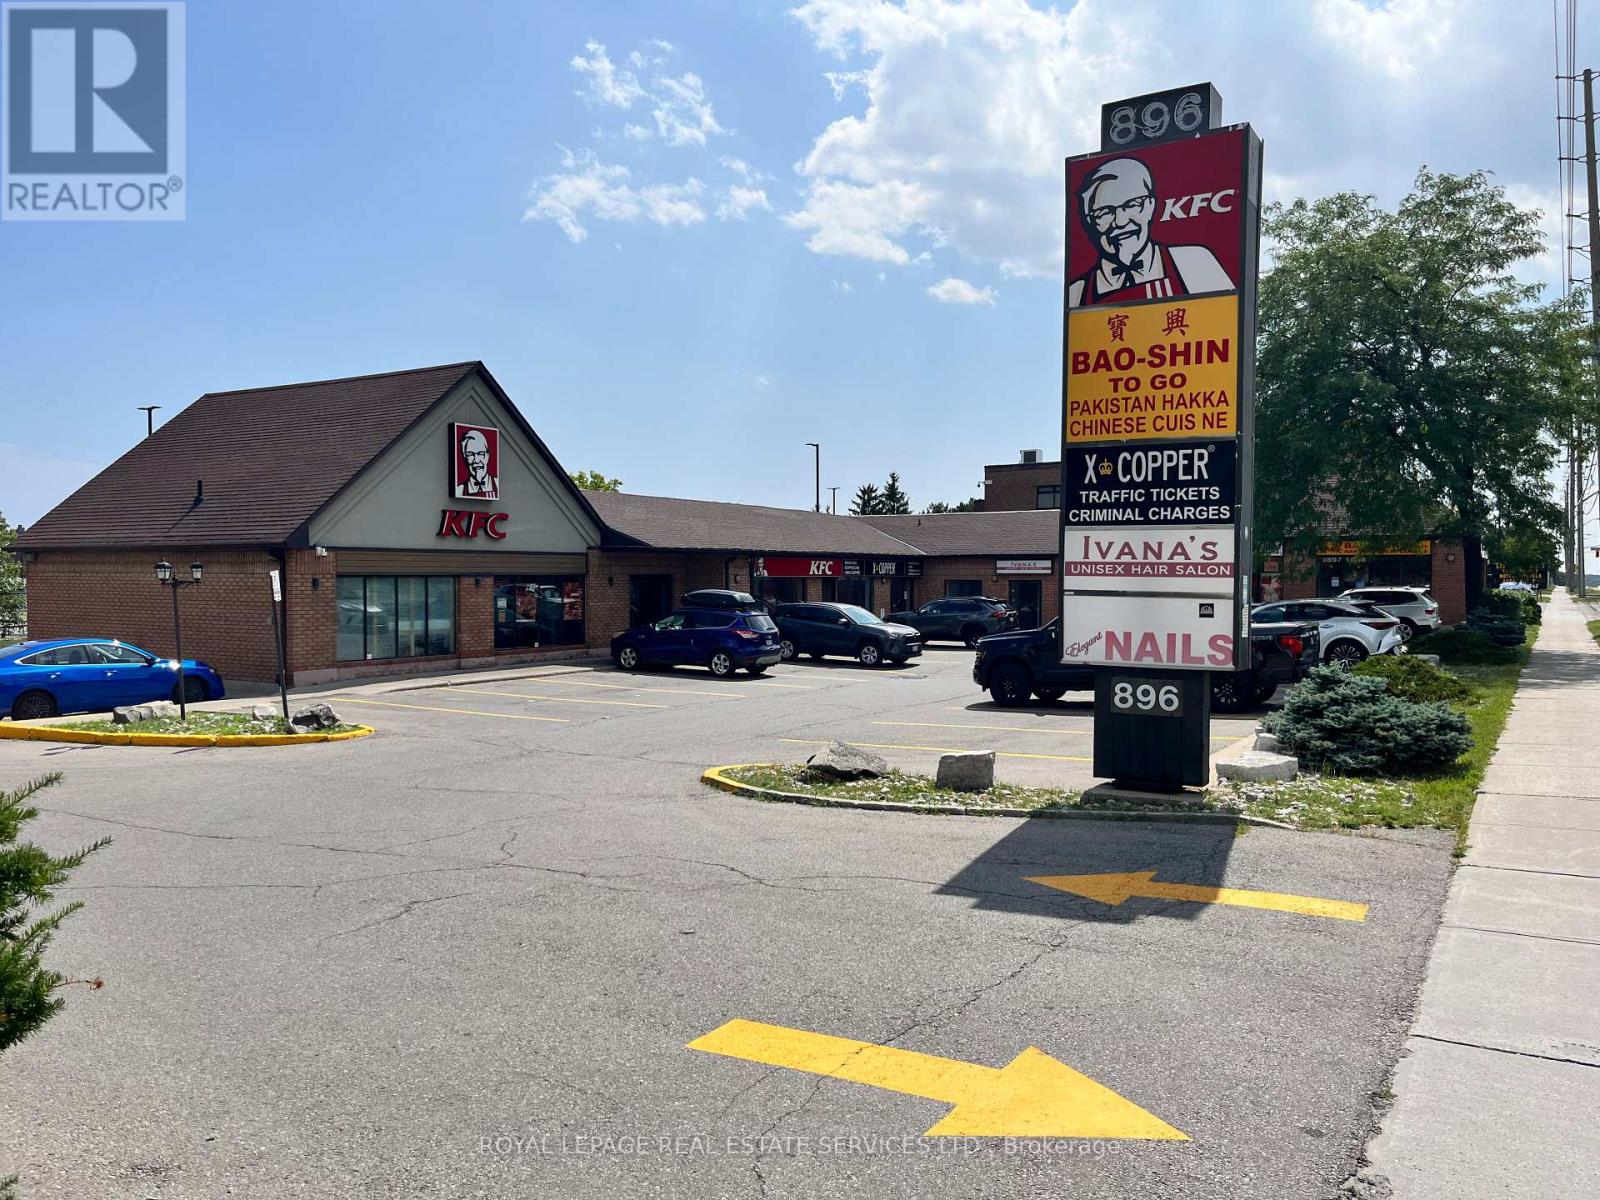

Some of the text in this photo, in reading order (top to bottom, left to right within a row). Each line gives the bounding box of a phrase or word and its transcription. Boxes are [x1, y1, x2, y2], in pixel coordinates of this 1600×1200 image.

[1110, 92, 1203, 145] 896
[1159, 189, 1236, 222] KFC
[1071, 338, 1230, 375] BAO-SHIN
[1108, 372, 1187, 393] TO GO
[1070, 390, 1230, 417] PAKISTAN HAKKA
[1069, 416, 1147, 437] CHINESE
[1084, 454, 1097, 484] X
[1079, 486, 1220, 503] TRAFFIC TICKETS
[436, 509, 509, 540] KFC
[1068, 506, 1231, 522] CRIMINAL CHARGES
[1082, 535, 1218, 561] IVANA'S
[809, 560, 833, 575] KFC
[1071, 564, 1231, 576] UNISEX HAIR SALON
[1104, 630, 1233, 666] NAILS
[1113, 682, 1179, 712] 896
